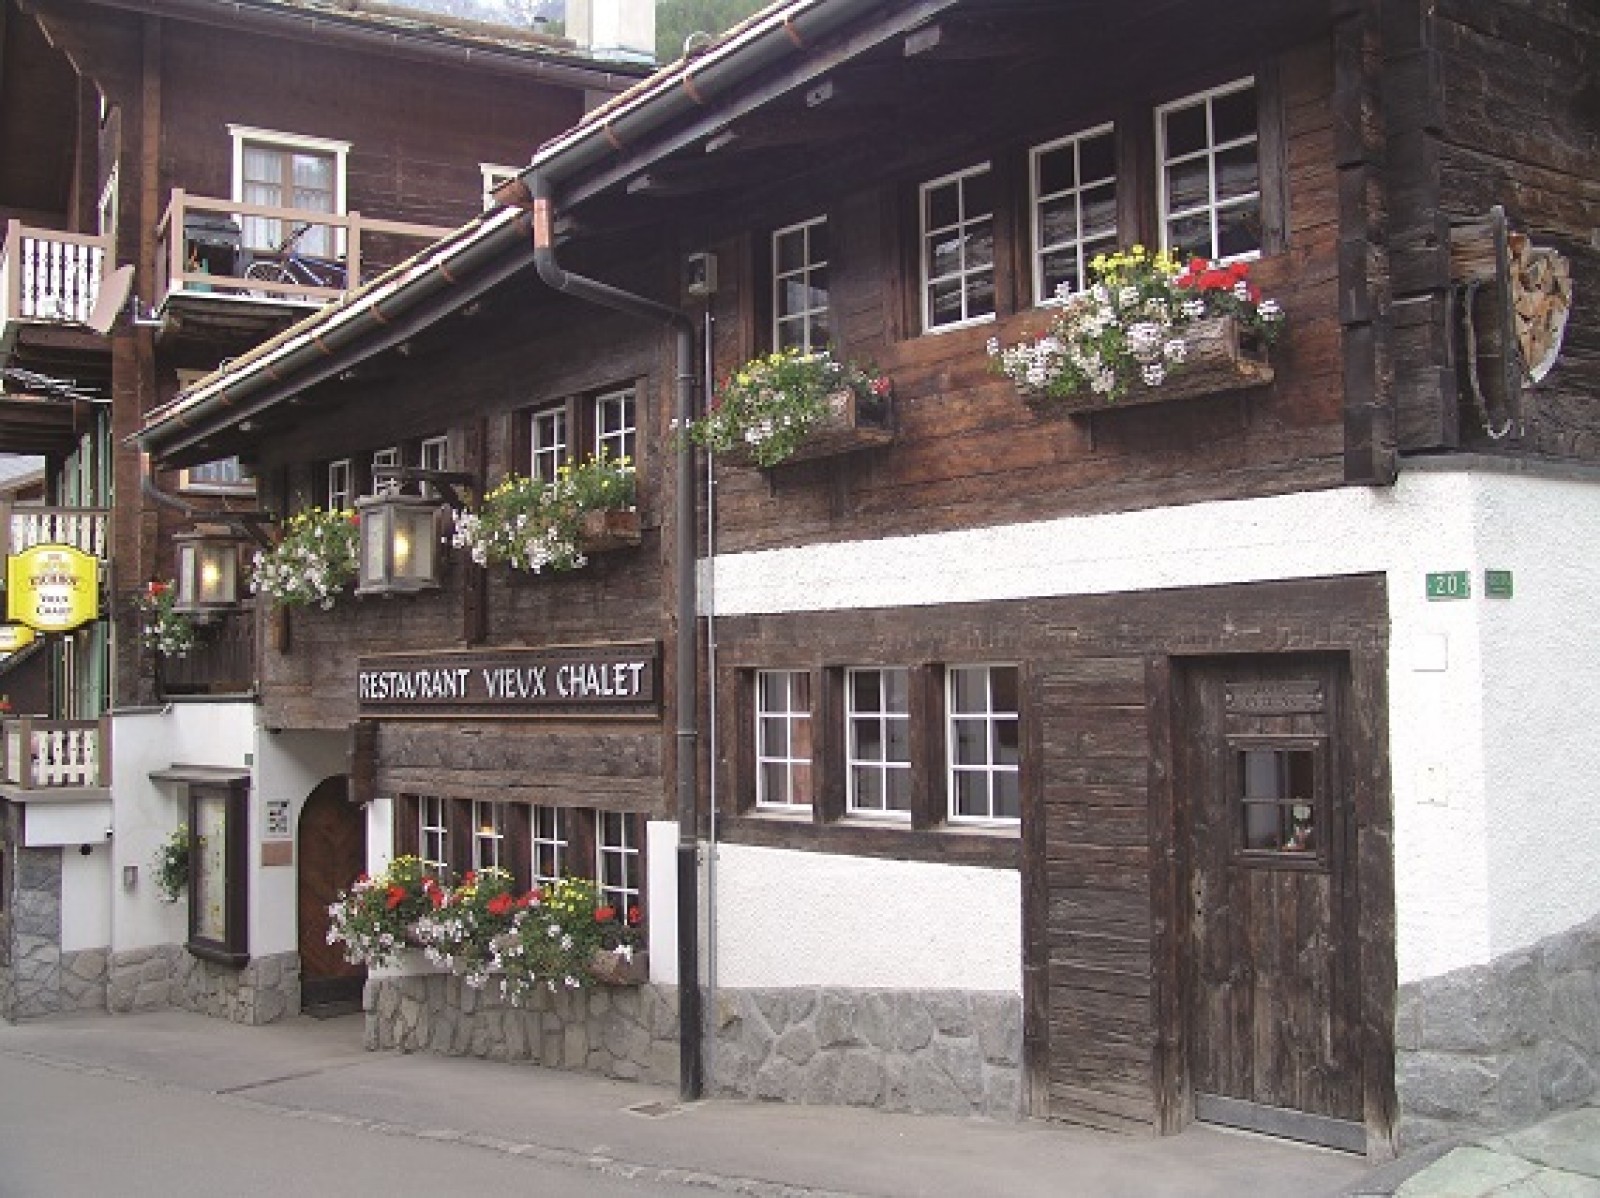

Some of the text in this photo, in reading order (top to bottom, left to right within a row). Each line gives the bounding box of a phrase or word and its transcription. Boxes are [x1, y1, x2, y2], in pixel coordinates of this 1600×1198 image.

[1436, 575, 1458, 594] 20
[359, 661, 646, 699] RESTAURANT VIEUX CHALET
